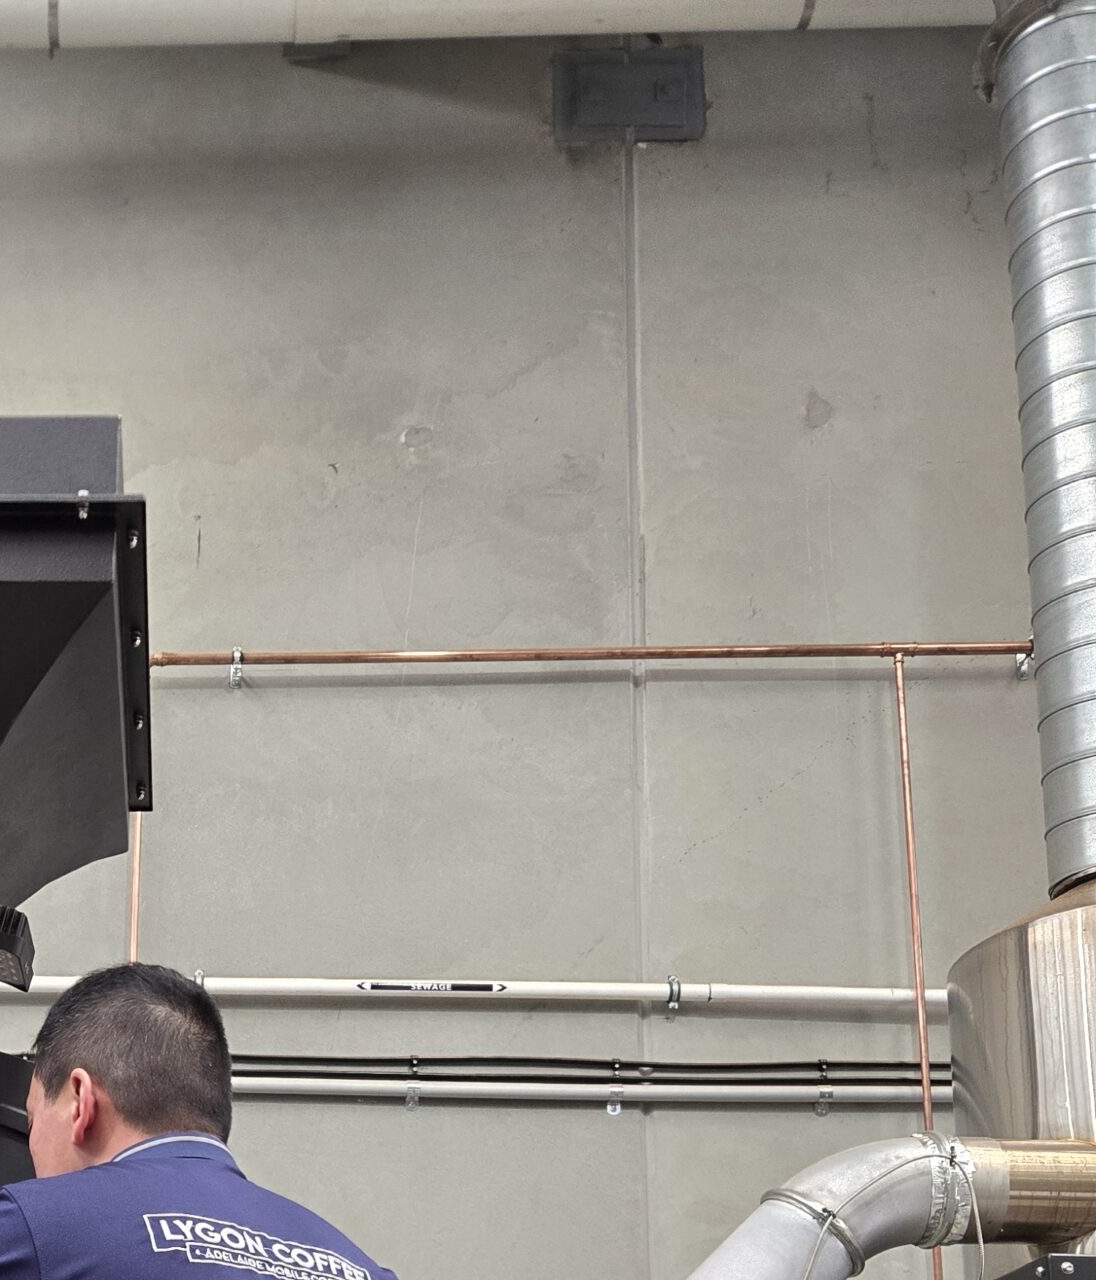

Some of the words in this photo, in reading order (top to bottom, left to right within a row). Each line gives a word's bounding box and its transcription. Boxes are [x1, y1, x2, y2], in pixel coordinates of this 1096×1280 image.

[410, 983, 452, 991] SEWAGE
[159, 1219, 268, 1258] LYGON
[204, 1247, 264, 1270] ADELAIDE
